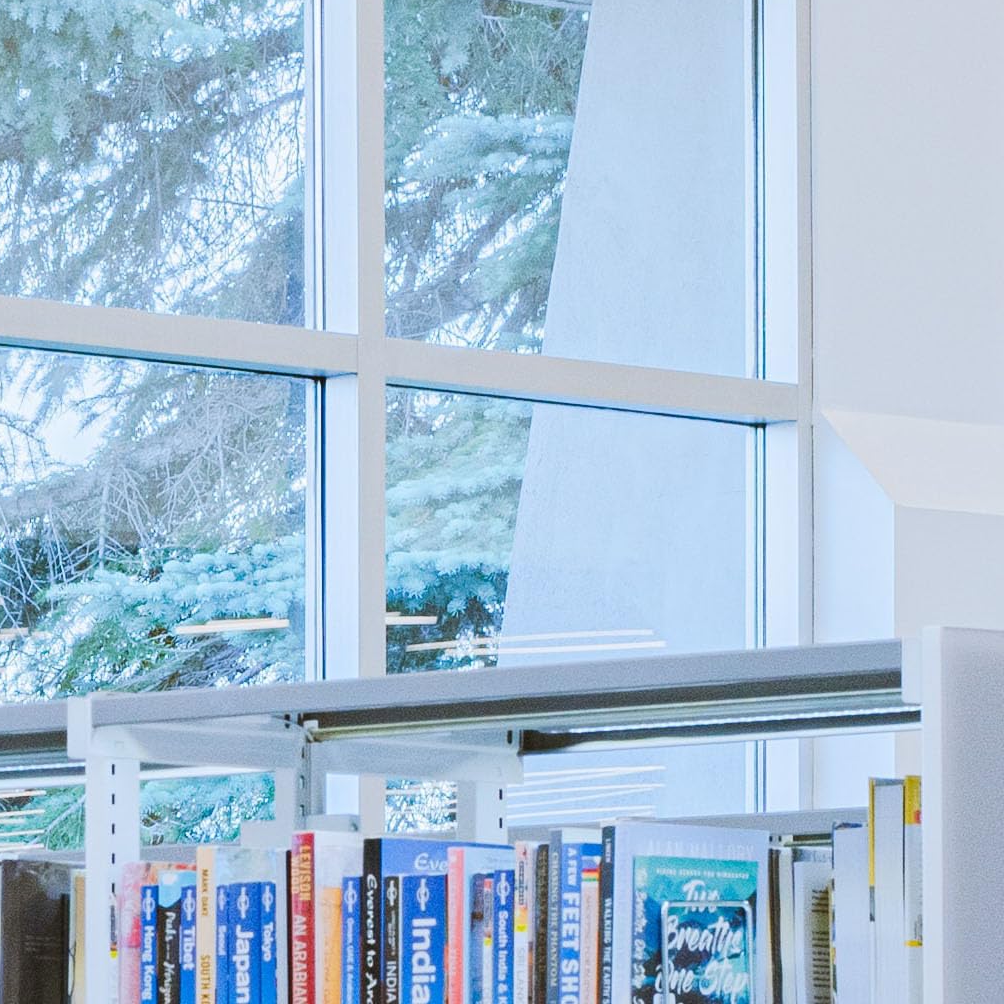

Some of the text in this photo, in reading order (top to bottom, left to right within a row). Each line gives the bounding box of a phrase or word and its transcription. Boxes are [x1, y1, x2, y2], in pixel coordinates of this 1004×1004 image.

[299, 845, 312, 901] LEVISON
[567, 847, 577, 858] A
[567, 859, 578, 887] FEW
[366, 873, 378, 946] Everest
[682, 879, 720, 914] Two
[293, 914, 307, 936] AN
[497, 910, 509, 948] South
[550, 851, 560, 987] CHASING THE PHANTOM
[562, 892, 580, 952] FEET
[602, 897, 612, 944] WALKING
[182, 925, 196, 971] Tibet
[262, 921, 274, 962] Tokyo
[366, 949, 378, 968] to
[411, 917, 437, 1004] India
[602, 946, 612, 963] THE
[141, 925, 155, 1001] Hong Kong
[200, 953, 211, 990] SOUTH
[232, 924, 254, 1004] Japan
[386, 960, 396, 1003] INDIA
[497, 950, 509, 980] India
[654, 956, 750, 1004] One Step
[497, 983, 509, 993] &
